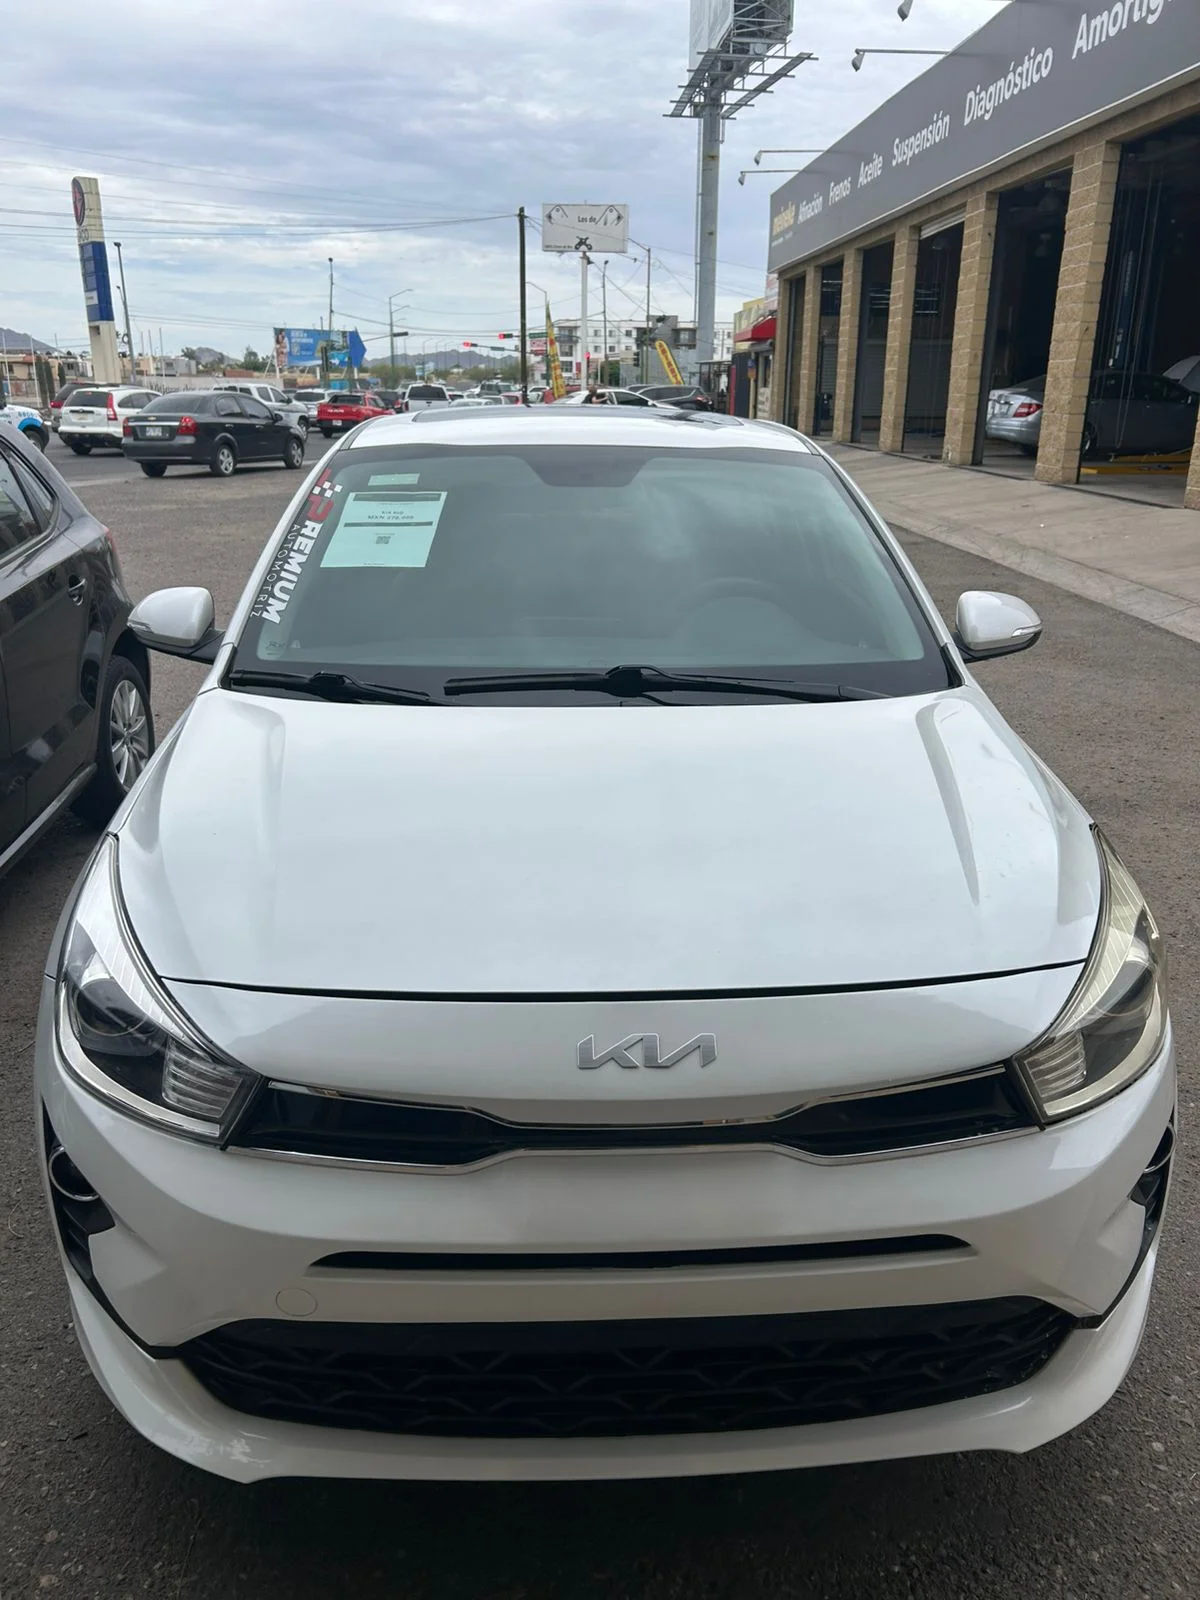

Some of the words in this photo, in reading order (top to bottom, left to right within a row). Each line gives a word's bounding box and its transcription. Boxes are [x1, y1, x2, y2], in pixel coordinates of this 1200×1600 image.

[828, 177, 851, 206] Frenos
[857, 152, 883, 189] Aceite
[892, 110, 951, 166] Suspensión
[964, 48, 1054, 126] Diagnóstico
[1071, 0, 1171, 60] Amortig
[250, 523, 301, 617] AUTOMOTRIZ
[262, 490, 336, 625] PREMIUM
[577, 1032, 717, 1069] KIA
